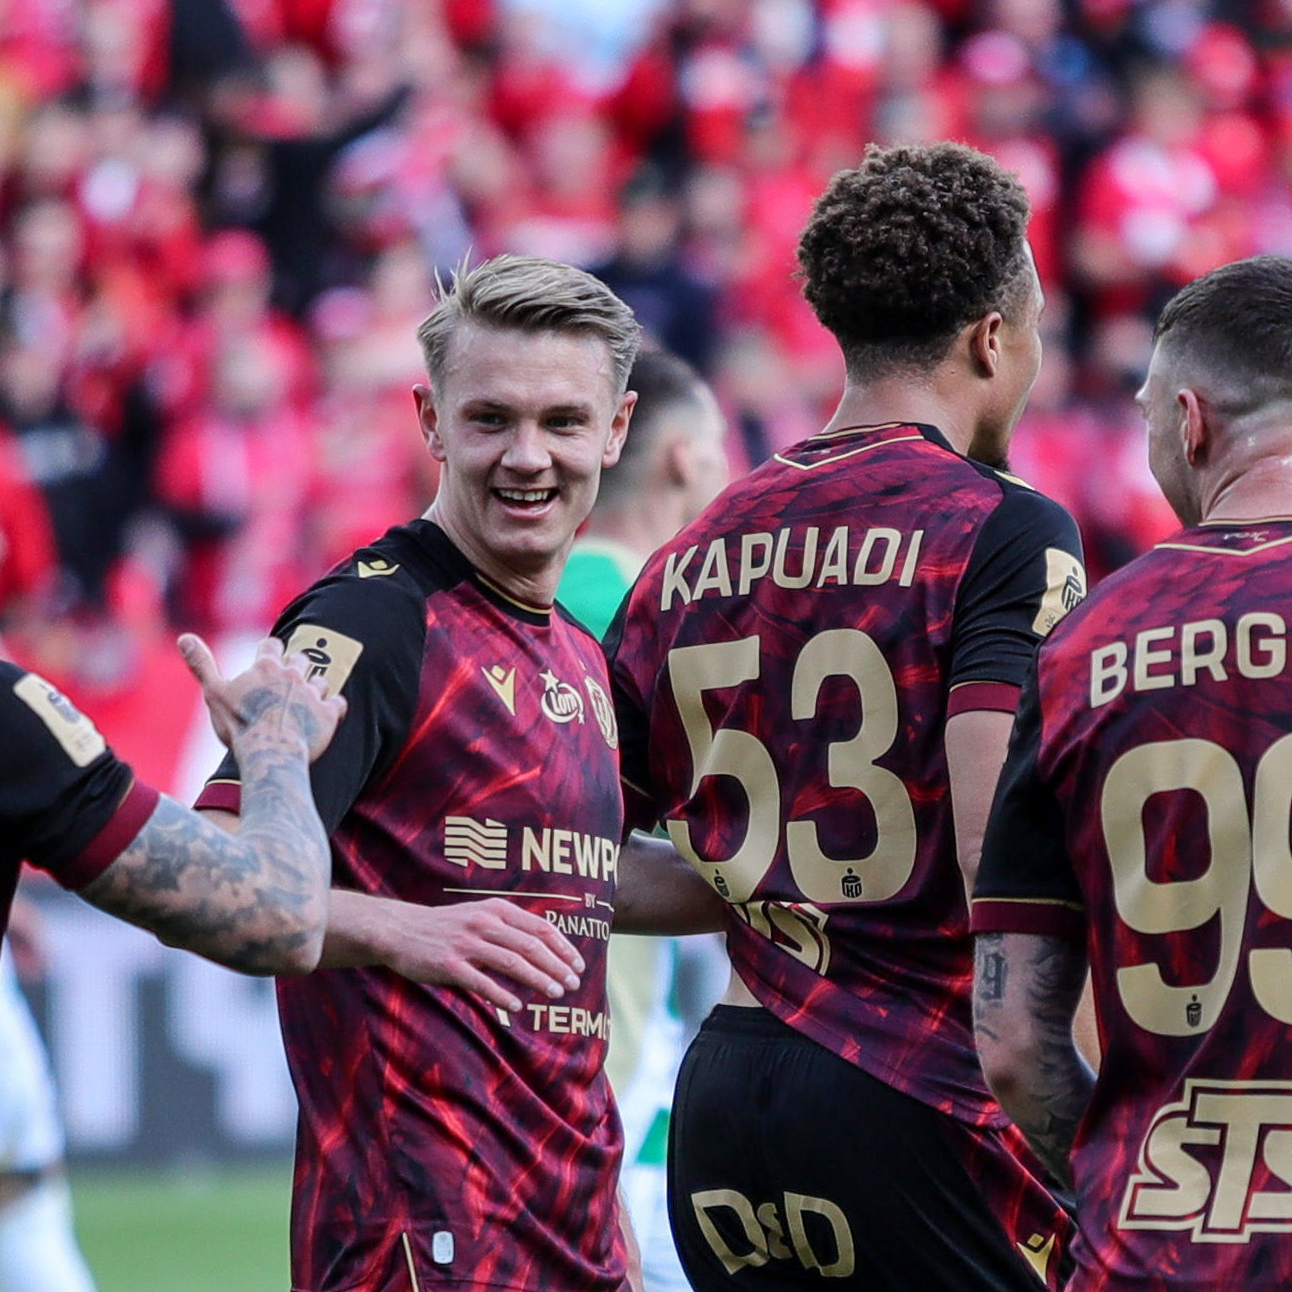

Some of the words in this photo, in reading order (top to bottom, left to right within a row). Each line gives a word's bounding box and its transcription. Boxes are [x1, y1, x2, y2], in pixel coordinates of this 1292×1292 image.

[660, 526, 924, 610] KAPUADI
[666, 628, 917, 903] 53
[522, 826, 621, 890] NEWP
[527, 1003, 611, 1041] TERM
